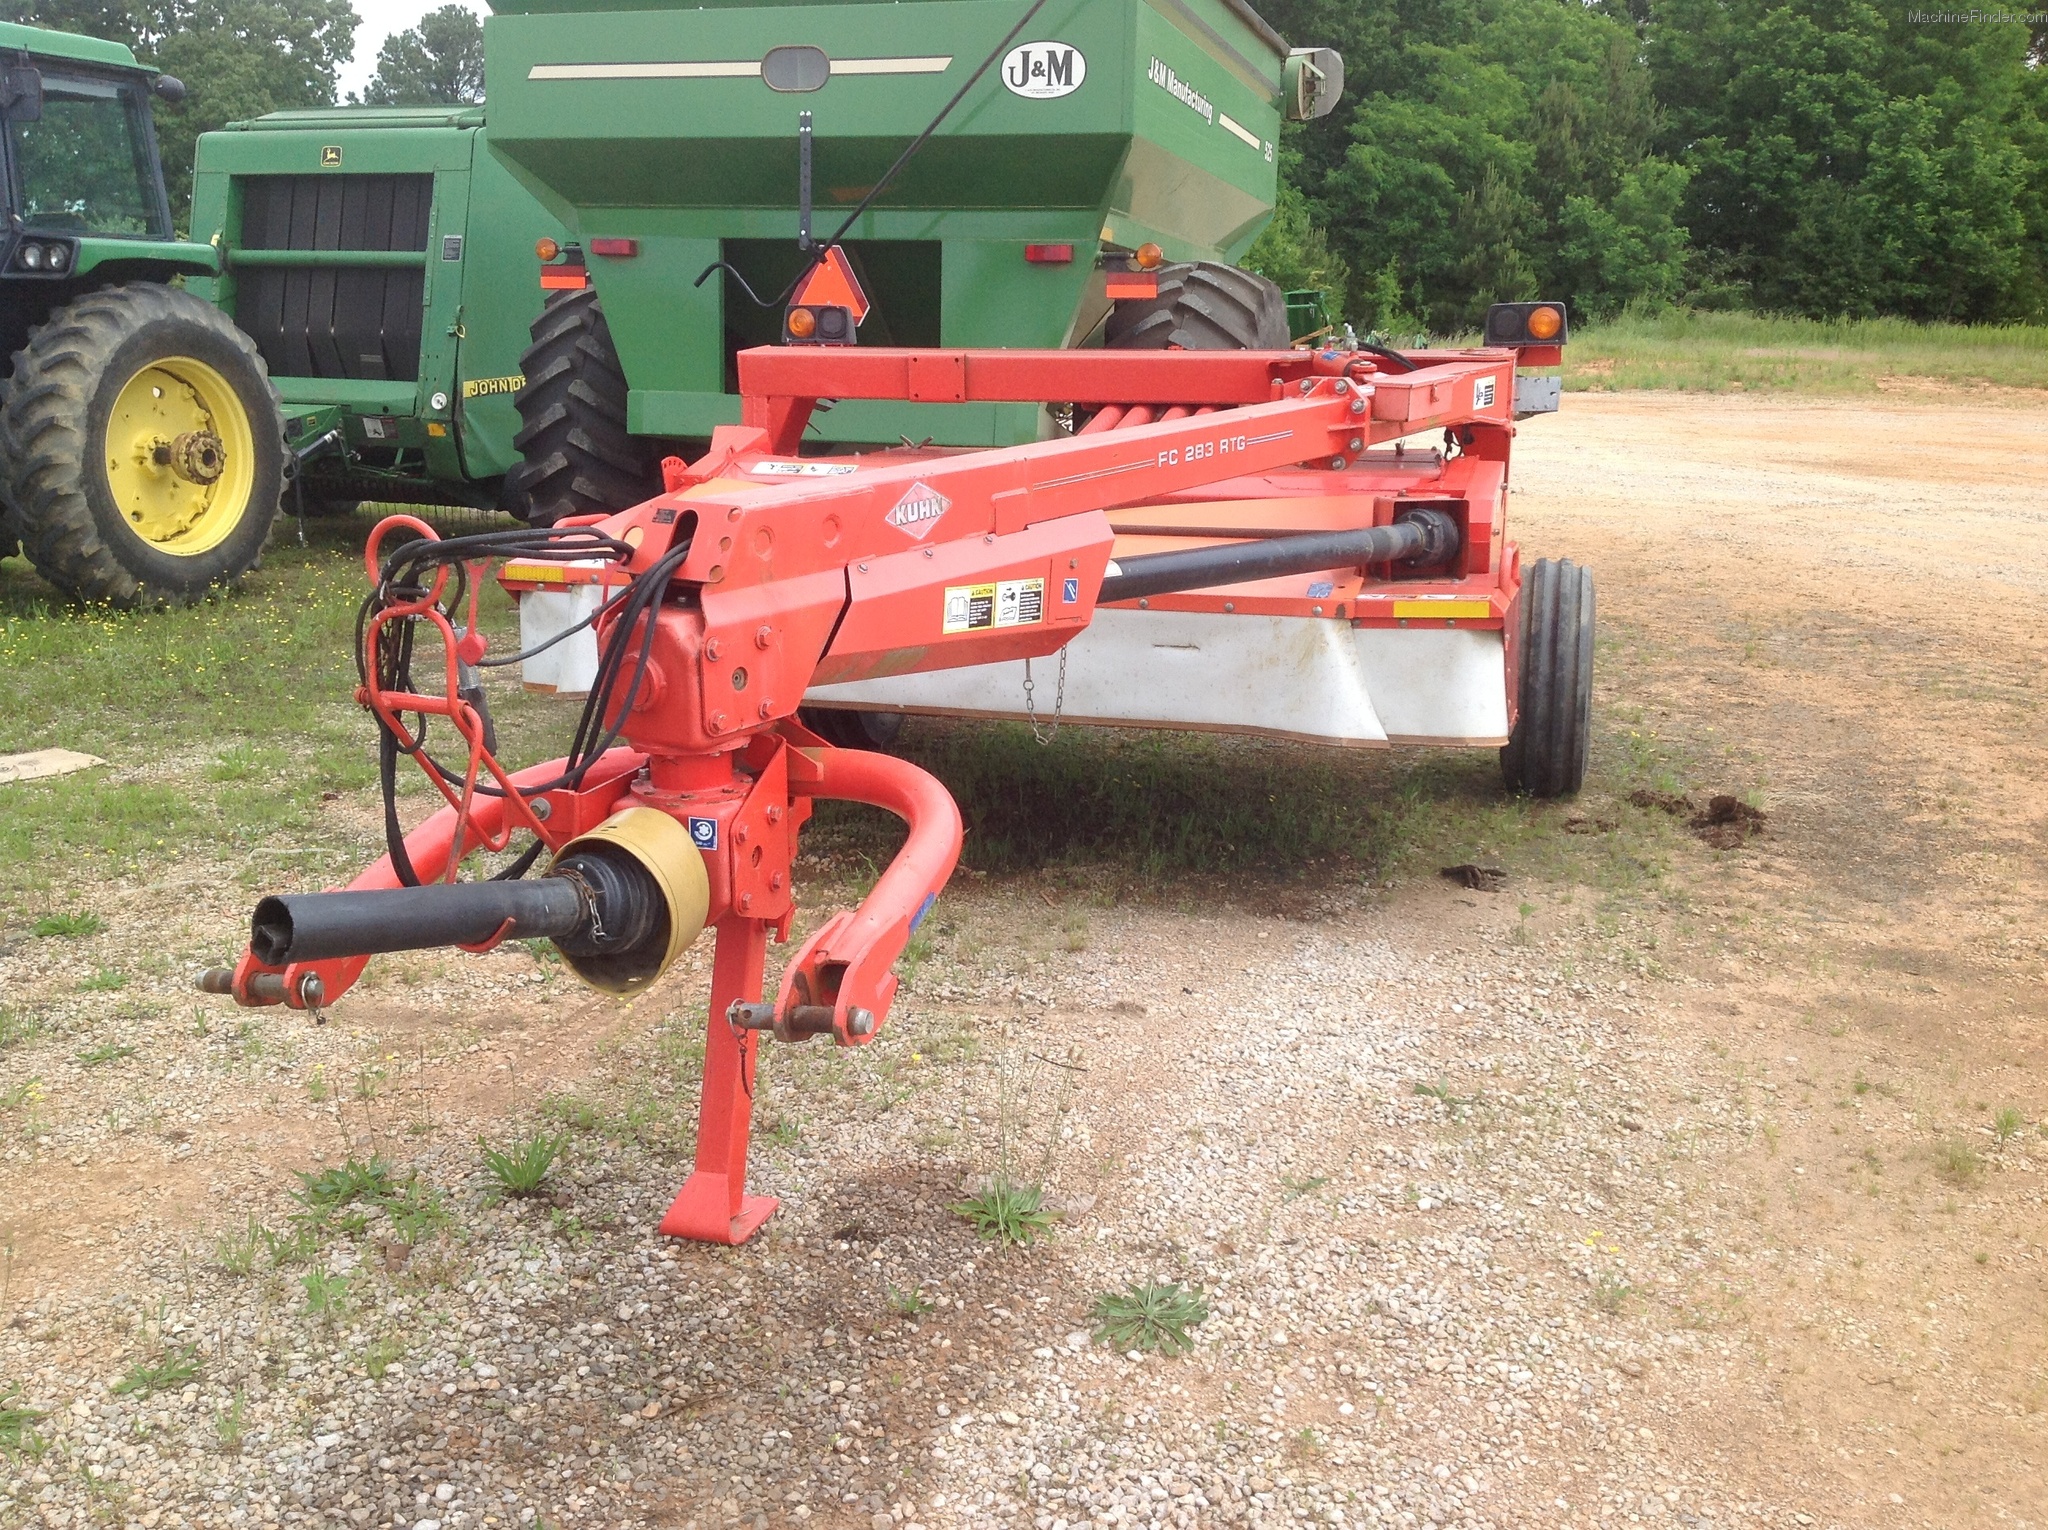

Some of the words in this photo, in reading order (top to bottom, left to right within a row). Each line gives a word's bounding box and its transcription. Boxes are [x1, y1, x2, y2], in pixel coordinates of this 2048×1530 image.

[1008, 49, 1075, 87] J&M
[1148, 55, 1167, 89] J&M
[1166, 67, 1213, 126] Manufacturing
[470, 378, 508, 397] JOHN
[1158, 449, 1179, 468] FC
[1185, 441, 1214, 462] 283
[1220, 435, 1246, 454] RTG
[894, 496, 944, 526] KUHN
[975, 588, 993, 596] CAUTION
